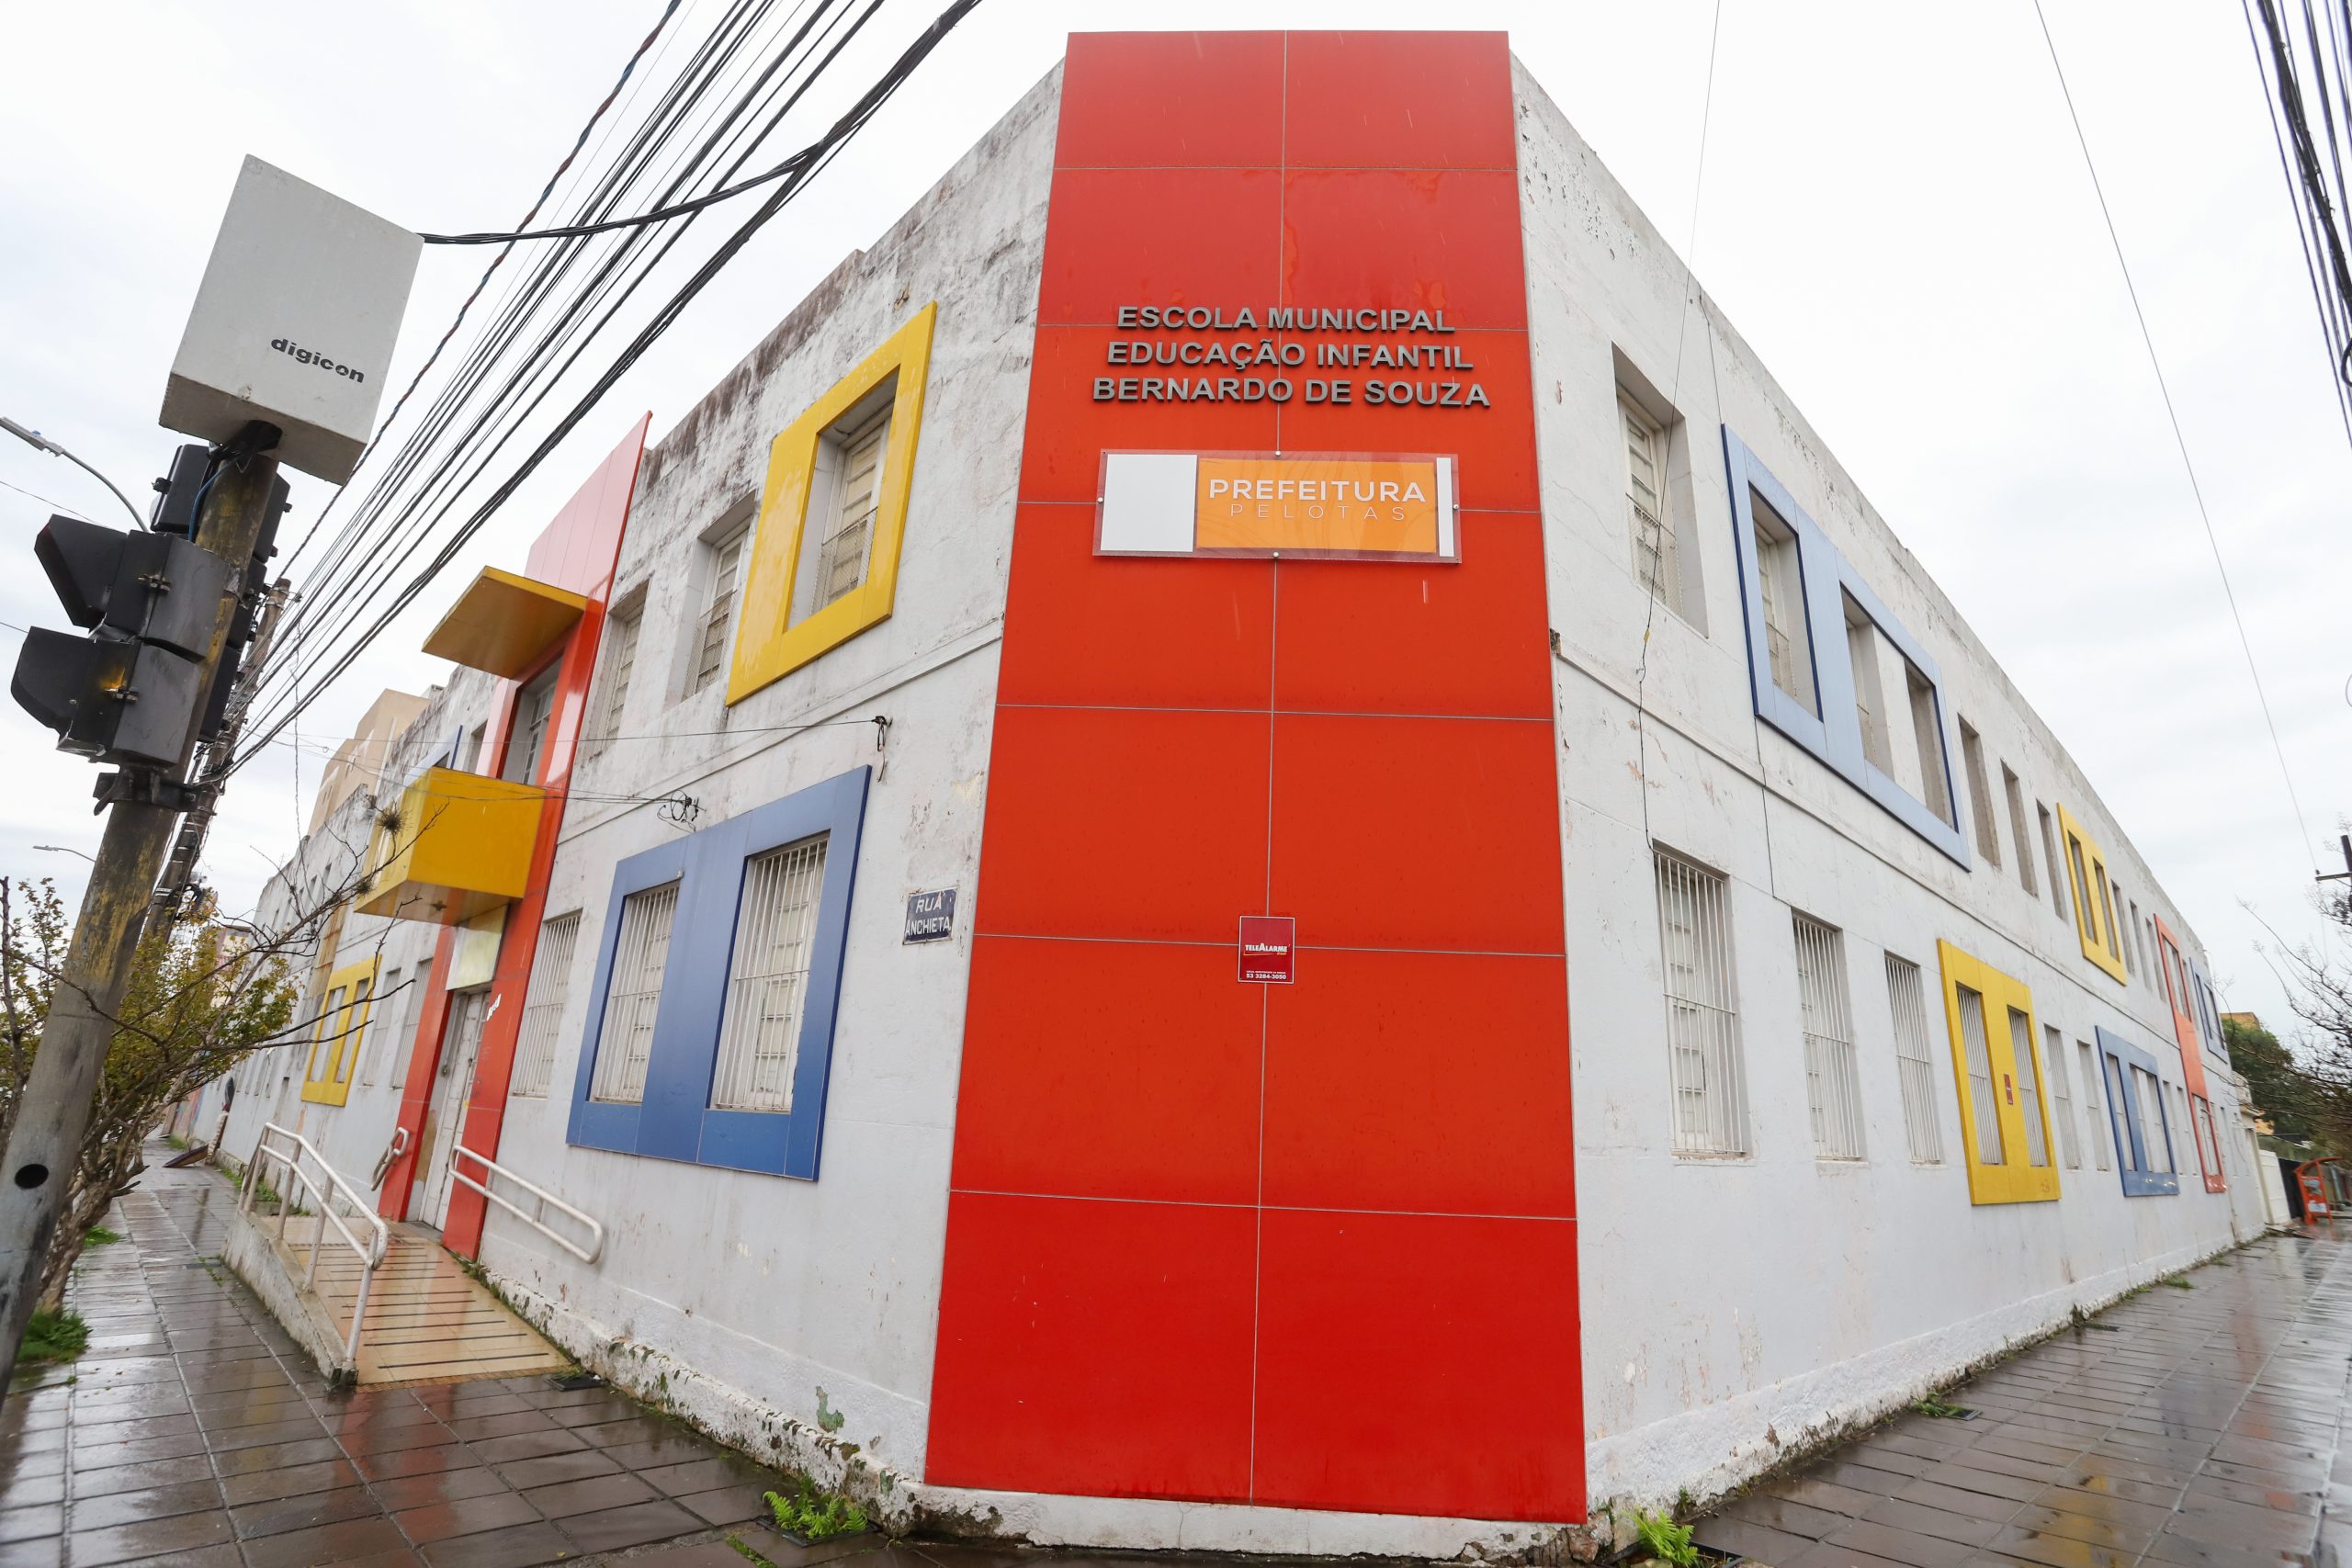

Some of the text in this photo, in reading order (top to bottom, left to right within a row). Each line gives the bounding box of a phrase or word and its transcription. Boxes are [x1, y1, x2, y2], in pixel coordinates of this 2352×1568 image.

[1117, 306, 1455, 332] ESCOLA MUNICIPAL
[271, 338, 365, 383] digicon
[1108, 338, 1474, 371] EDUCAÇÃO INFANTIL
[1092, 377, 1491, 407] BERNARDO DE SOUZA
[1209, 479, 1426, 502] PREFEITURA
[1230, 503, 1406, 522] PELOTAS
[915, 893, 942, 913] RUA
[905, 916, 950, 936] ANCHIETA
